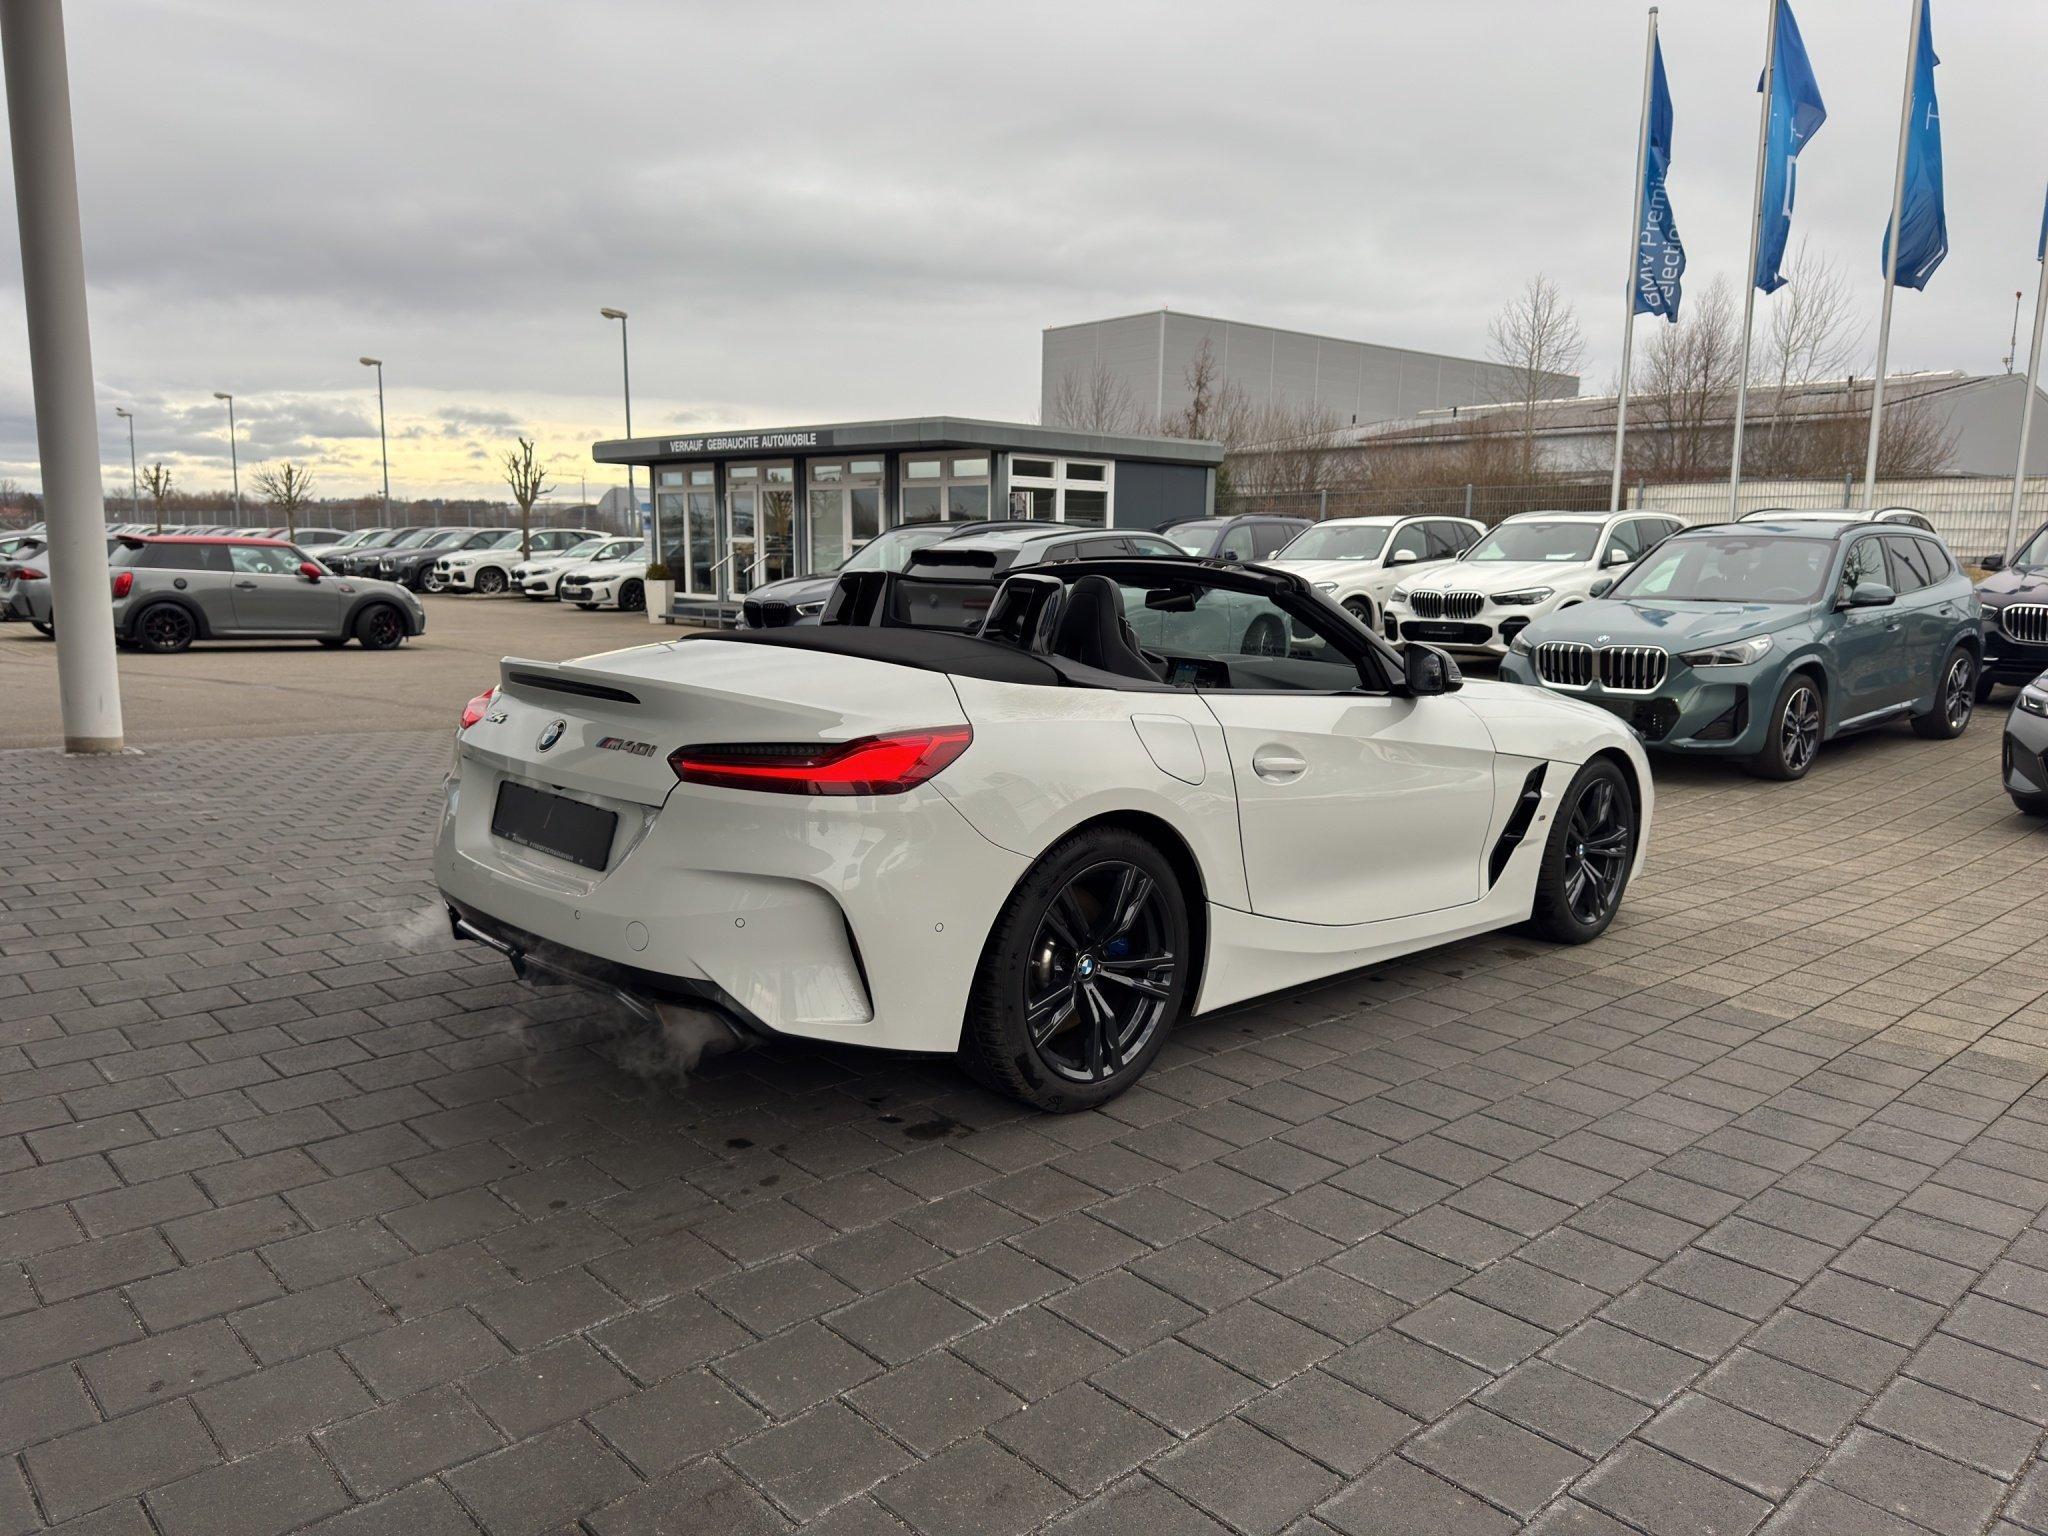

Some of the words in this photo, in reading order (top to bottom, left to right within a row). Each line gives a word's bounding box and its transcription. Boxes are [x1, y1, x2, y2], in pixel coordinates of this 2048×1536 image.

[669, 440, 703, 453] VERKAUF
[707, 436, 759, 450] GEBRAUCHTE
[762, 433, 817, 447] AUTOMOBILE
